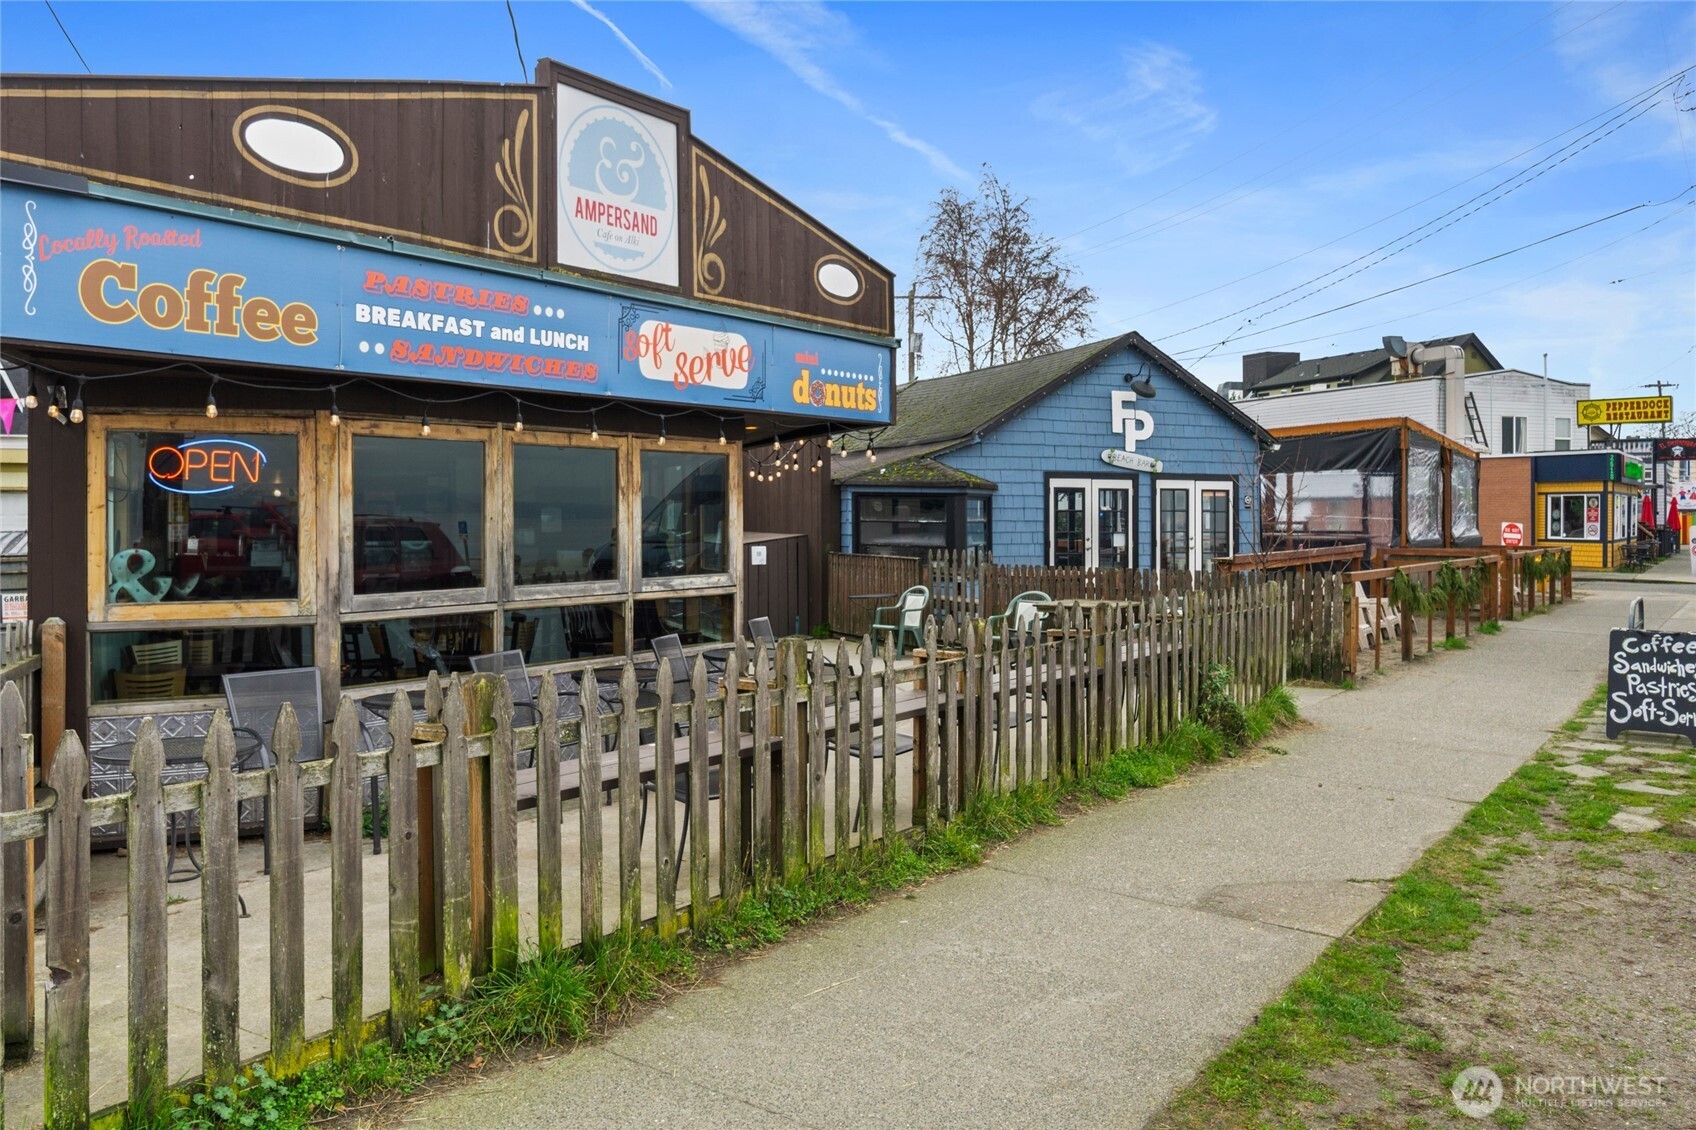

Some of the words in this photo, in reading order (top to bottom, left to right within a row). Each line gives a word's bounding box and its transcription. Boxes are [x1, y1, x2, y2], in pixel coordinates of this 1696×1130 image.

[575, 196, 658, 237] AMPERSAND
[38, 227, 119, 262] Locally
[123, 224, 204, 251] Roasted
[596, 228, 613, 242] Cafe
[614, 234, 624, 243] on
[624, 234, 640, 247] Alki
[78, 258, 320, 347] Coffee
[364, 271, 529, 316] PASTRIES
[355, 303, 485, 337] BREAKFAST
[490, 325, 525, 344] and
[528, 327, 589, 352] LUNCH
[623, 321, 677, 370] soft
[391, 340, 599, 382] SANDWICHES
[673, 344, 755, 391] serve
[795, 351, 819, 366] mini
[792, 367, 877, 412] donuts
[1606, 400, 1669, 411] PEPPERDOCK
[1606, 410, 1669, 421] RESTAURANT
[149, 446, 261, 484] OPEN
[1112, 453, 1134, 464] BEACH
[1137, 458, 1150, 467] BAR
[1621, 634, 1696, 654] Coffee
[1613, 651, 1696, 677] Sandwiche
